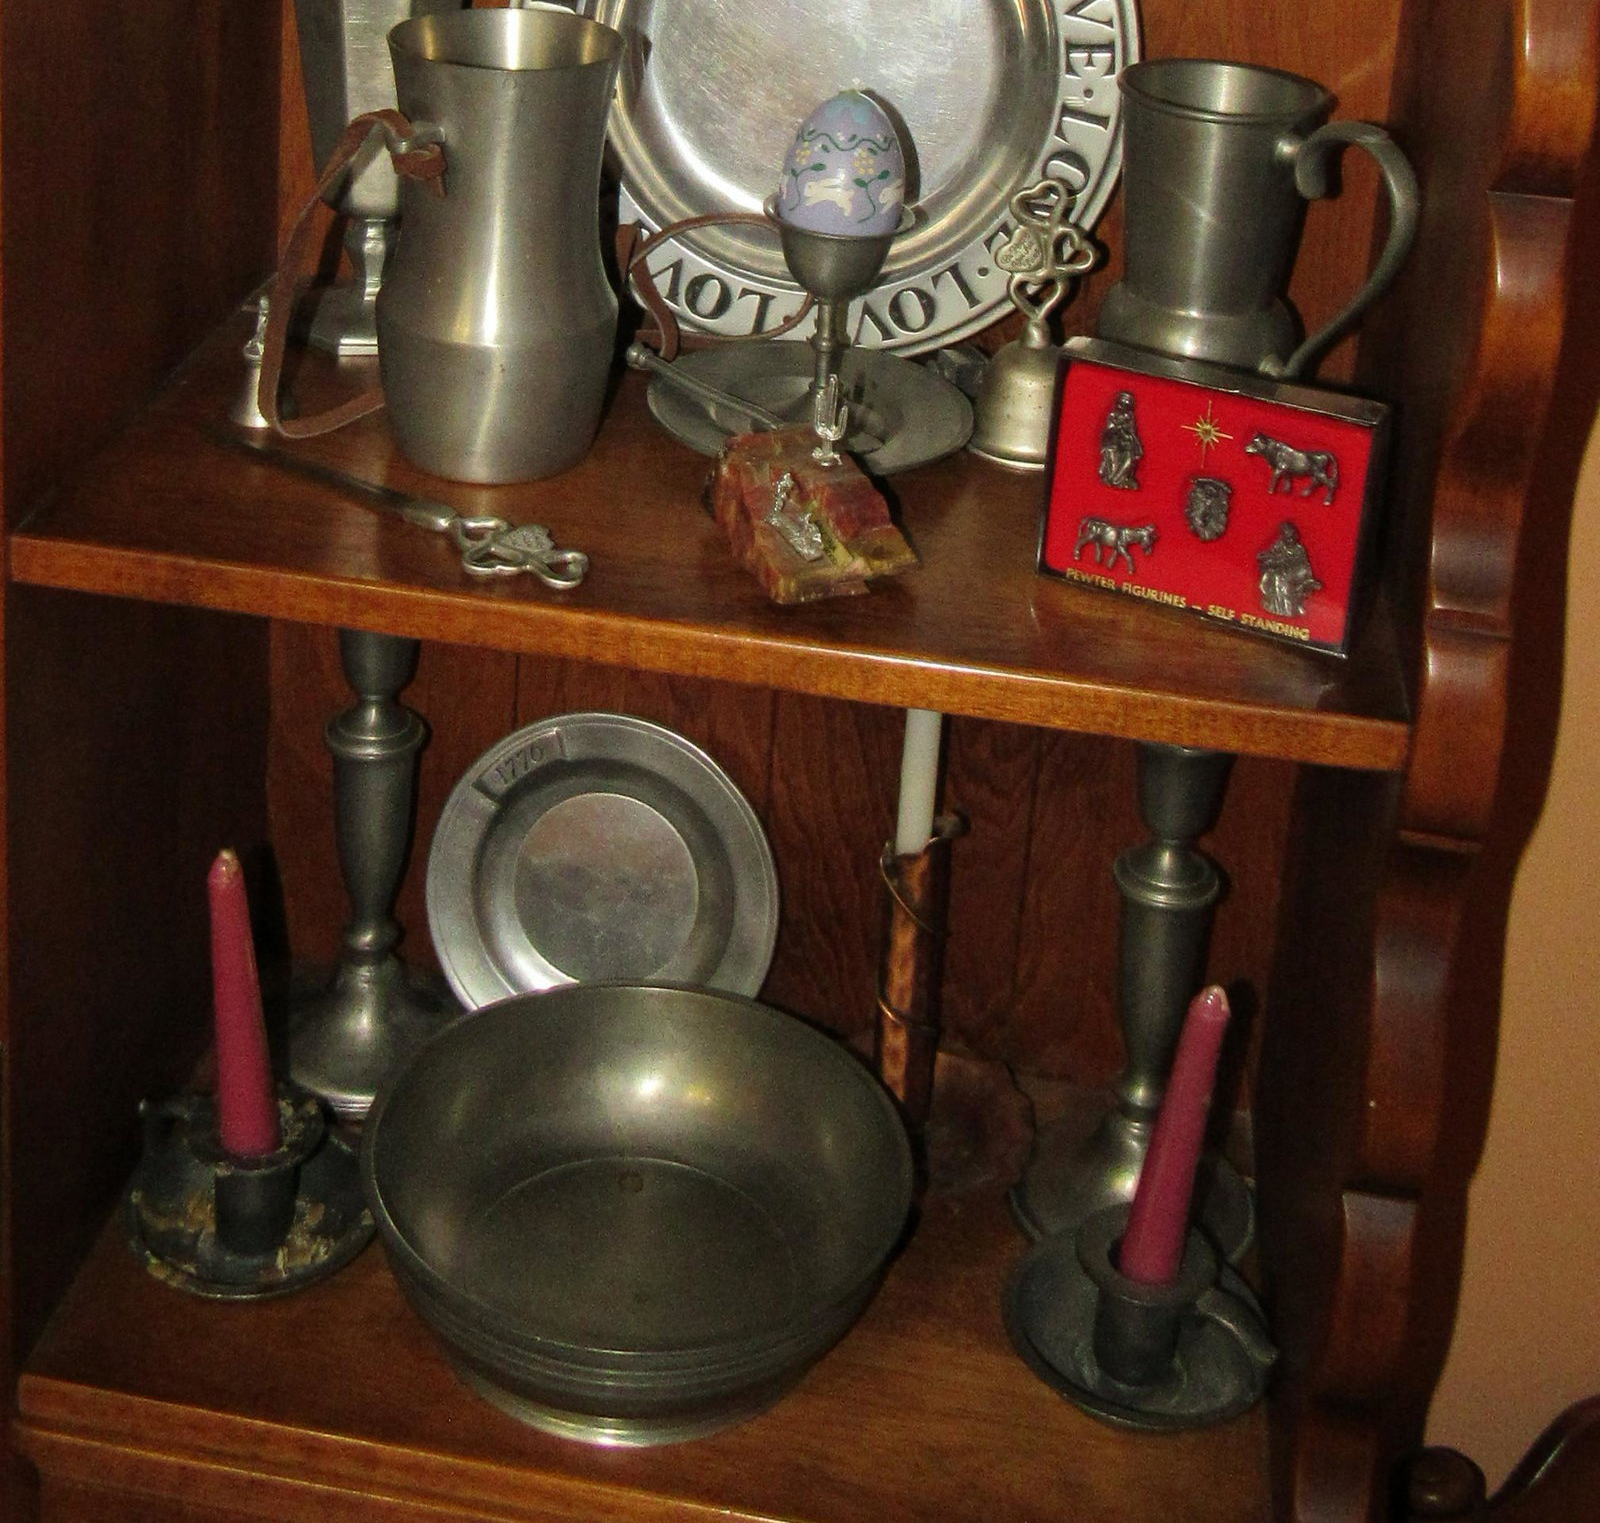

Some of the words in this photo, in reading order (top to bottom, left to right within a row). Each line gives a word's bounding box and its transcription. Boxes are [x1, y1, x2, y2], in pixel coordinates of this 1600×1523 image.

[852, 261, 982, 346] LOV
[1065, 567, 1116, 591] PEWTER
[1121, 581, 1187, 609] FIGURINES
[1207, 604, 1236, 621] SELF
[1240, 612, 1310, 642] STANDING
